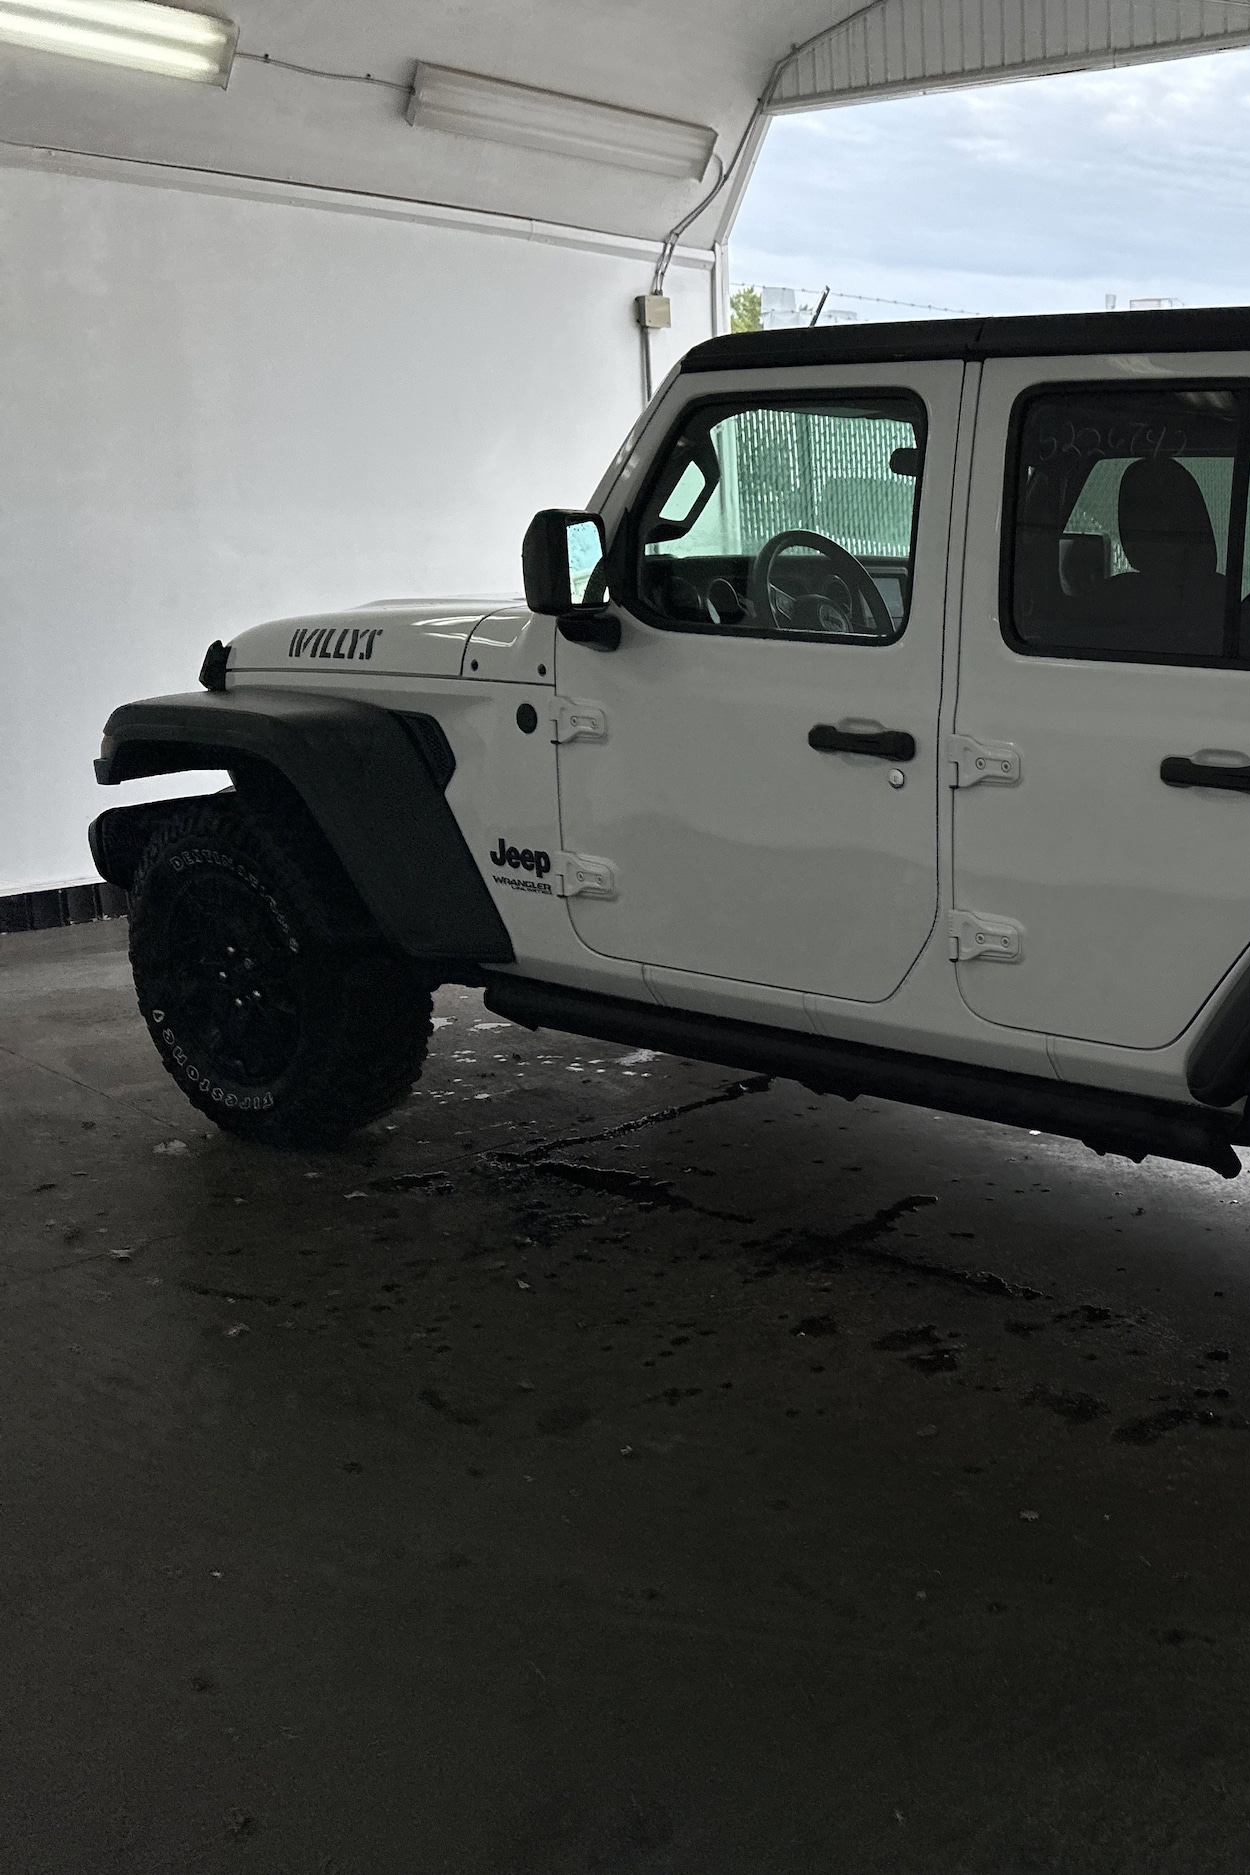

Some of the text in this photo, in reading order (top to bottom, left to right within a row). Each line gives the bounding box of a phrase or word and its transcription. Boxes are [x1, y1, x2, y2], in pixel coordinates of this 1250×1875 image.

[288, 628, 384, 660] WILLYS
[489, 837, 551, 879] Jeep
[491, 874, 552, 891] WRANGLER
